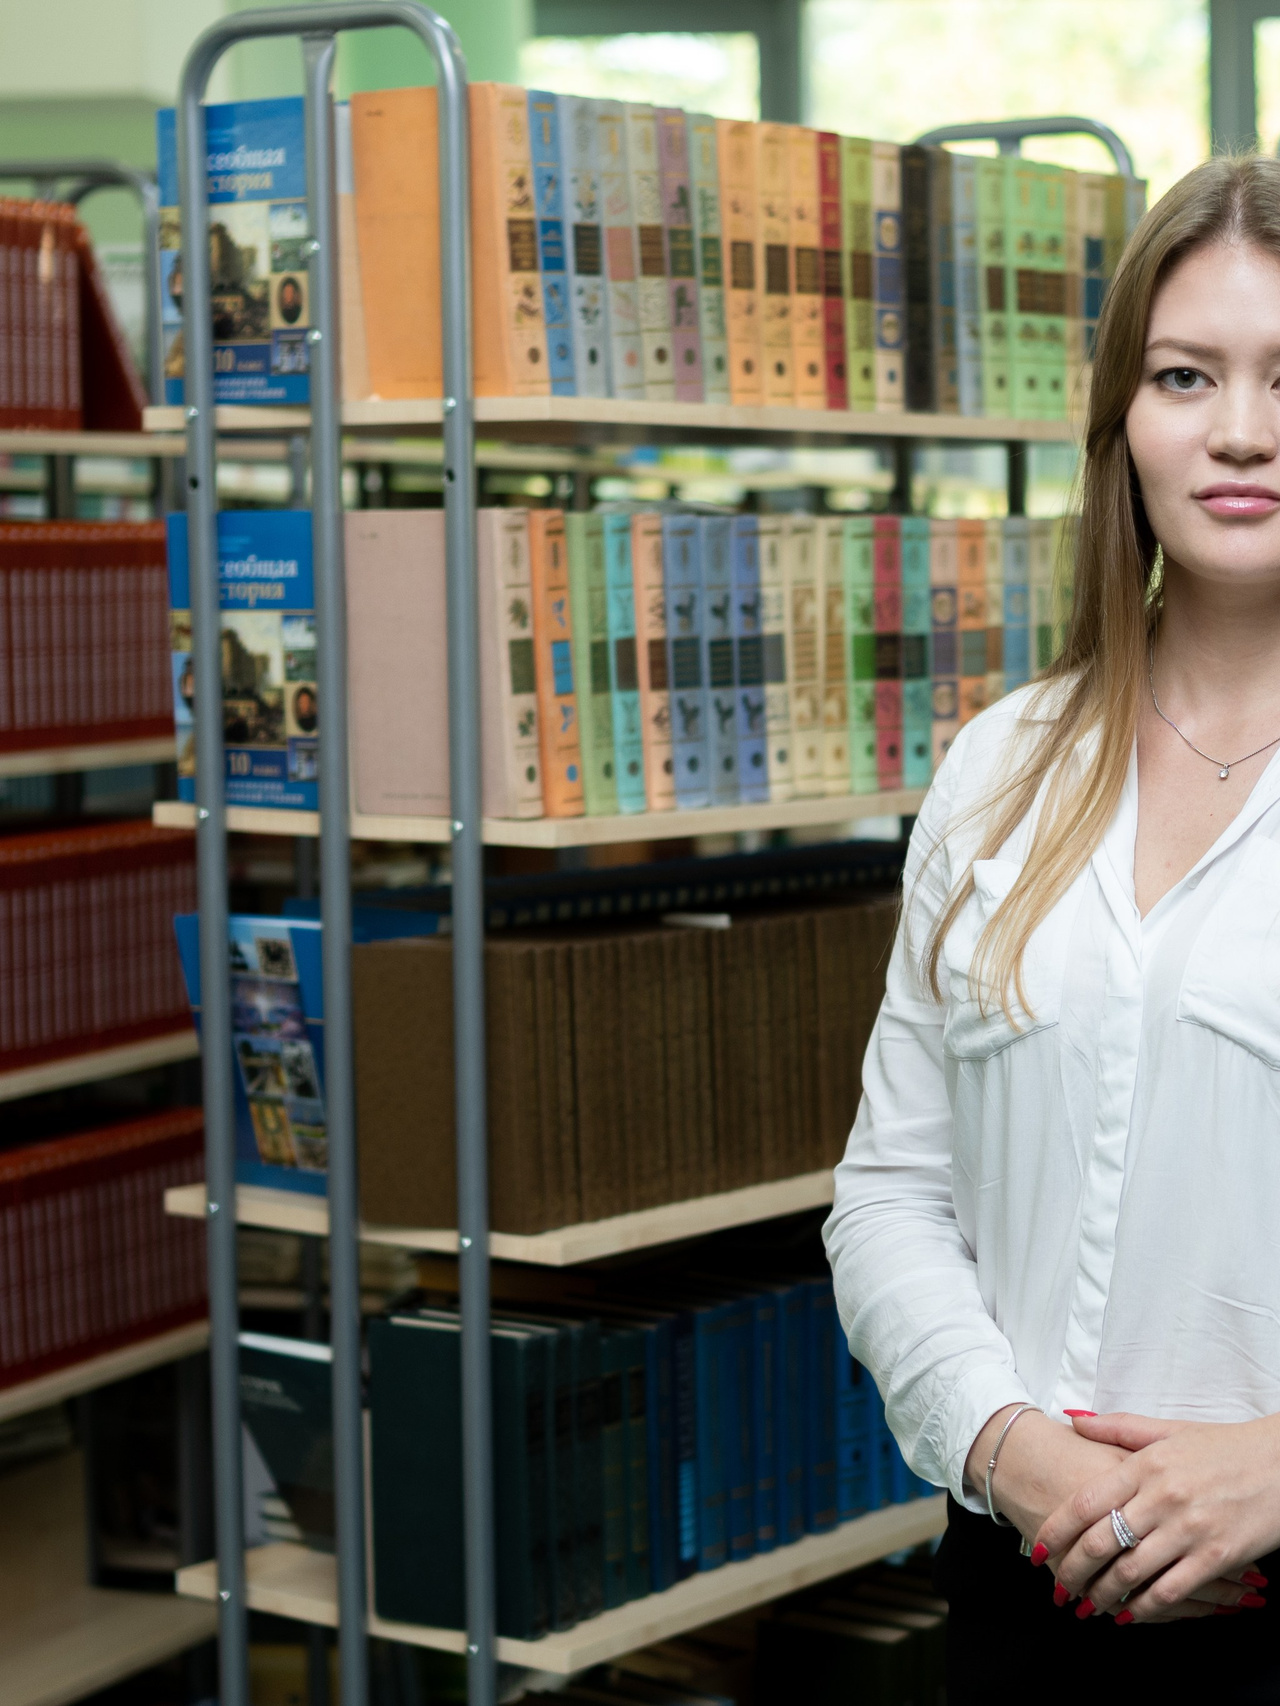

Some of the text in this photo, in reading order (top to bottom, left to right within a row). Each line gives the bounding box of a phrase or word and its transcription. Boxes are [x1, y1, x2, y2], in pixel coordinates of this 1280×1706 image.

[207, 144, 287, 170] сеобщая
[206, 171, 273, 198] стория
[219, 554, 298, 579] сеобщая
[219, 581, 286, 608] стория
[229, 751, 252, 776] 10
